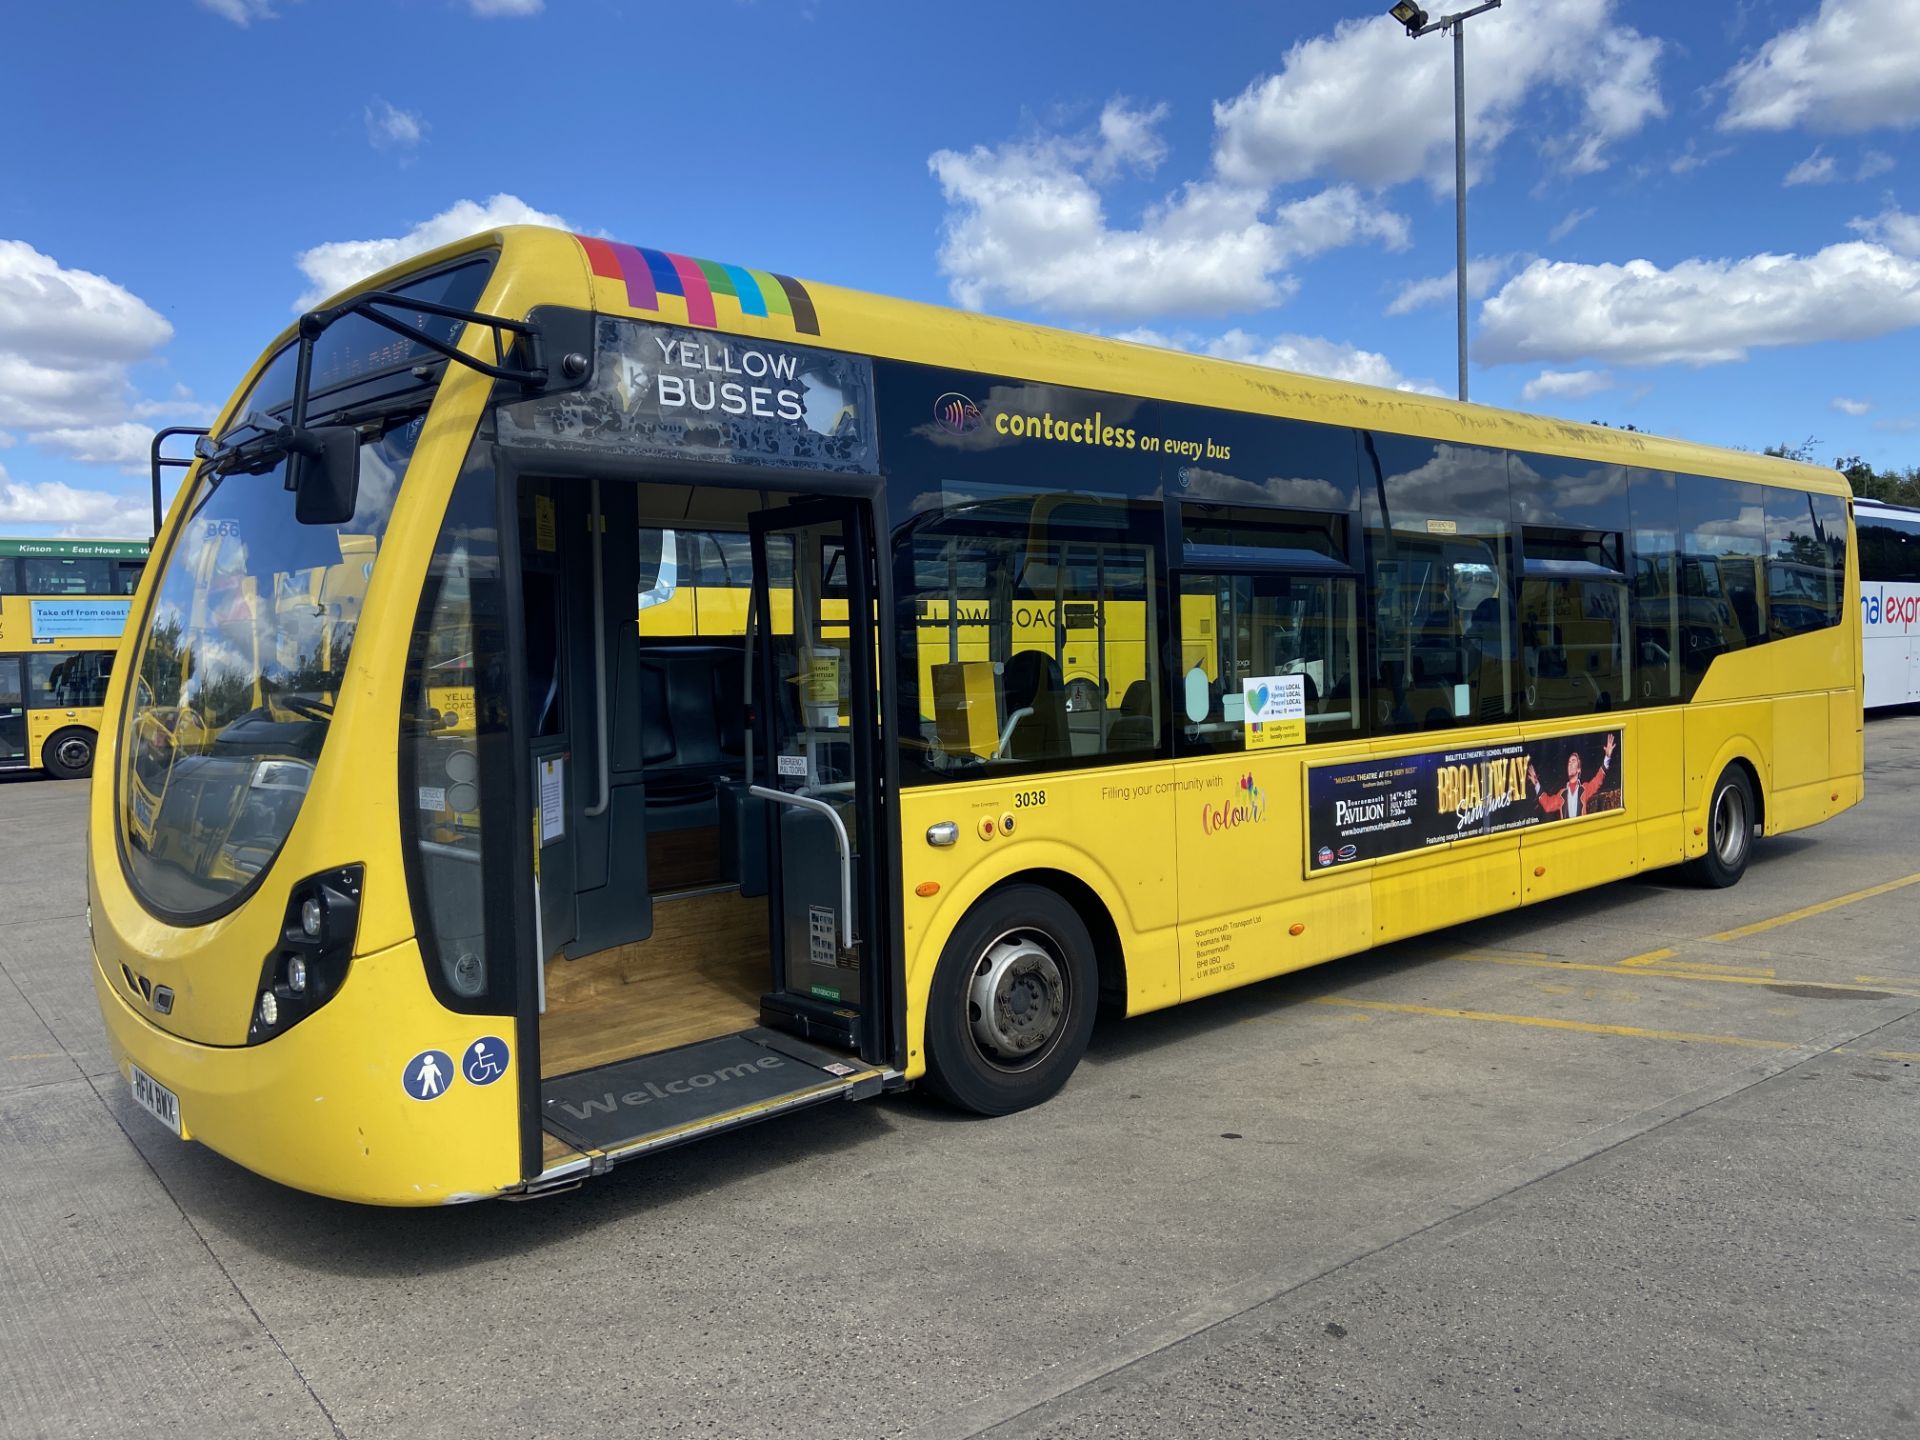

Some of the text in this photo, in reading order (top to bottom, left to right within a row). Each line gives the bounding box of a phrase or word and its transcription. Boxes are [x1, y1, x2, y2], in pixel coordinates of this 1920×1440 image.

[655, 337, 797, 380] YELLOW
[657, 374, 802, 420] BUSES
[995, 412, 1231, 461] contactless on every bus
[19, 545, 52, 553] Kinson
[72, 546, 92, 554] East
[95, 546, 121, 554] Howe
[445, 693, 475, 701] YELL
[1487, 748, 1501, 757] SCHOOL
[1502, 746, 1523, 754] PRESENTS
[1357, 772, 1378, 781] THEATRE
[1437, 755, 1531, 814] BROADWAY
[1101, 775, 1223, 801] Filling your community with
[1015, 790, 1046, 808] 3038
[1347, 794, 1384, 807] Bournemouth
[1390, 798, 1417, 809] JULY 2022
[1335, 801, 1385, 827] PAVILION
[1426, 836, 1445, 844] Featuring
[1195, 916, 1262, 938] Bournemouth Transport Ltd
[1197, 944, 1230, 958] Bournemouth
[560, 1054, 785, 1120] Welcome
